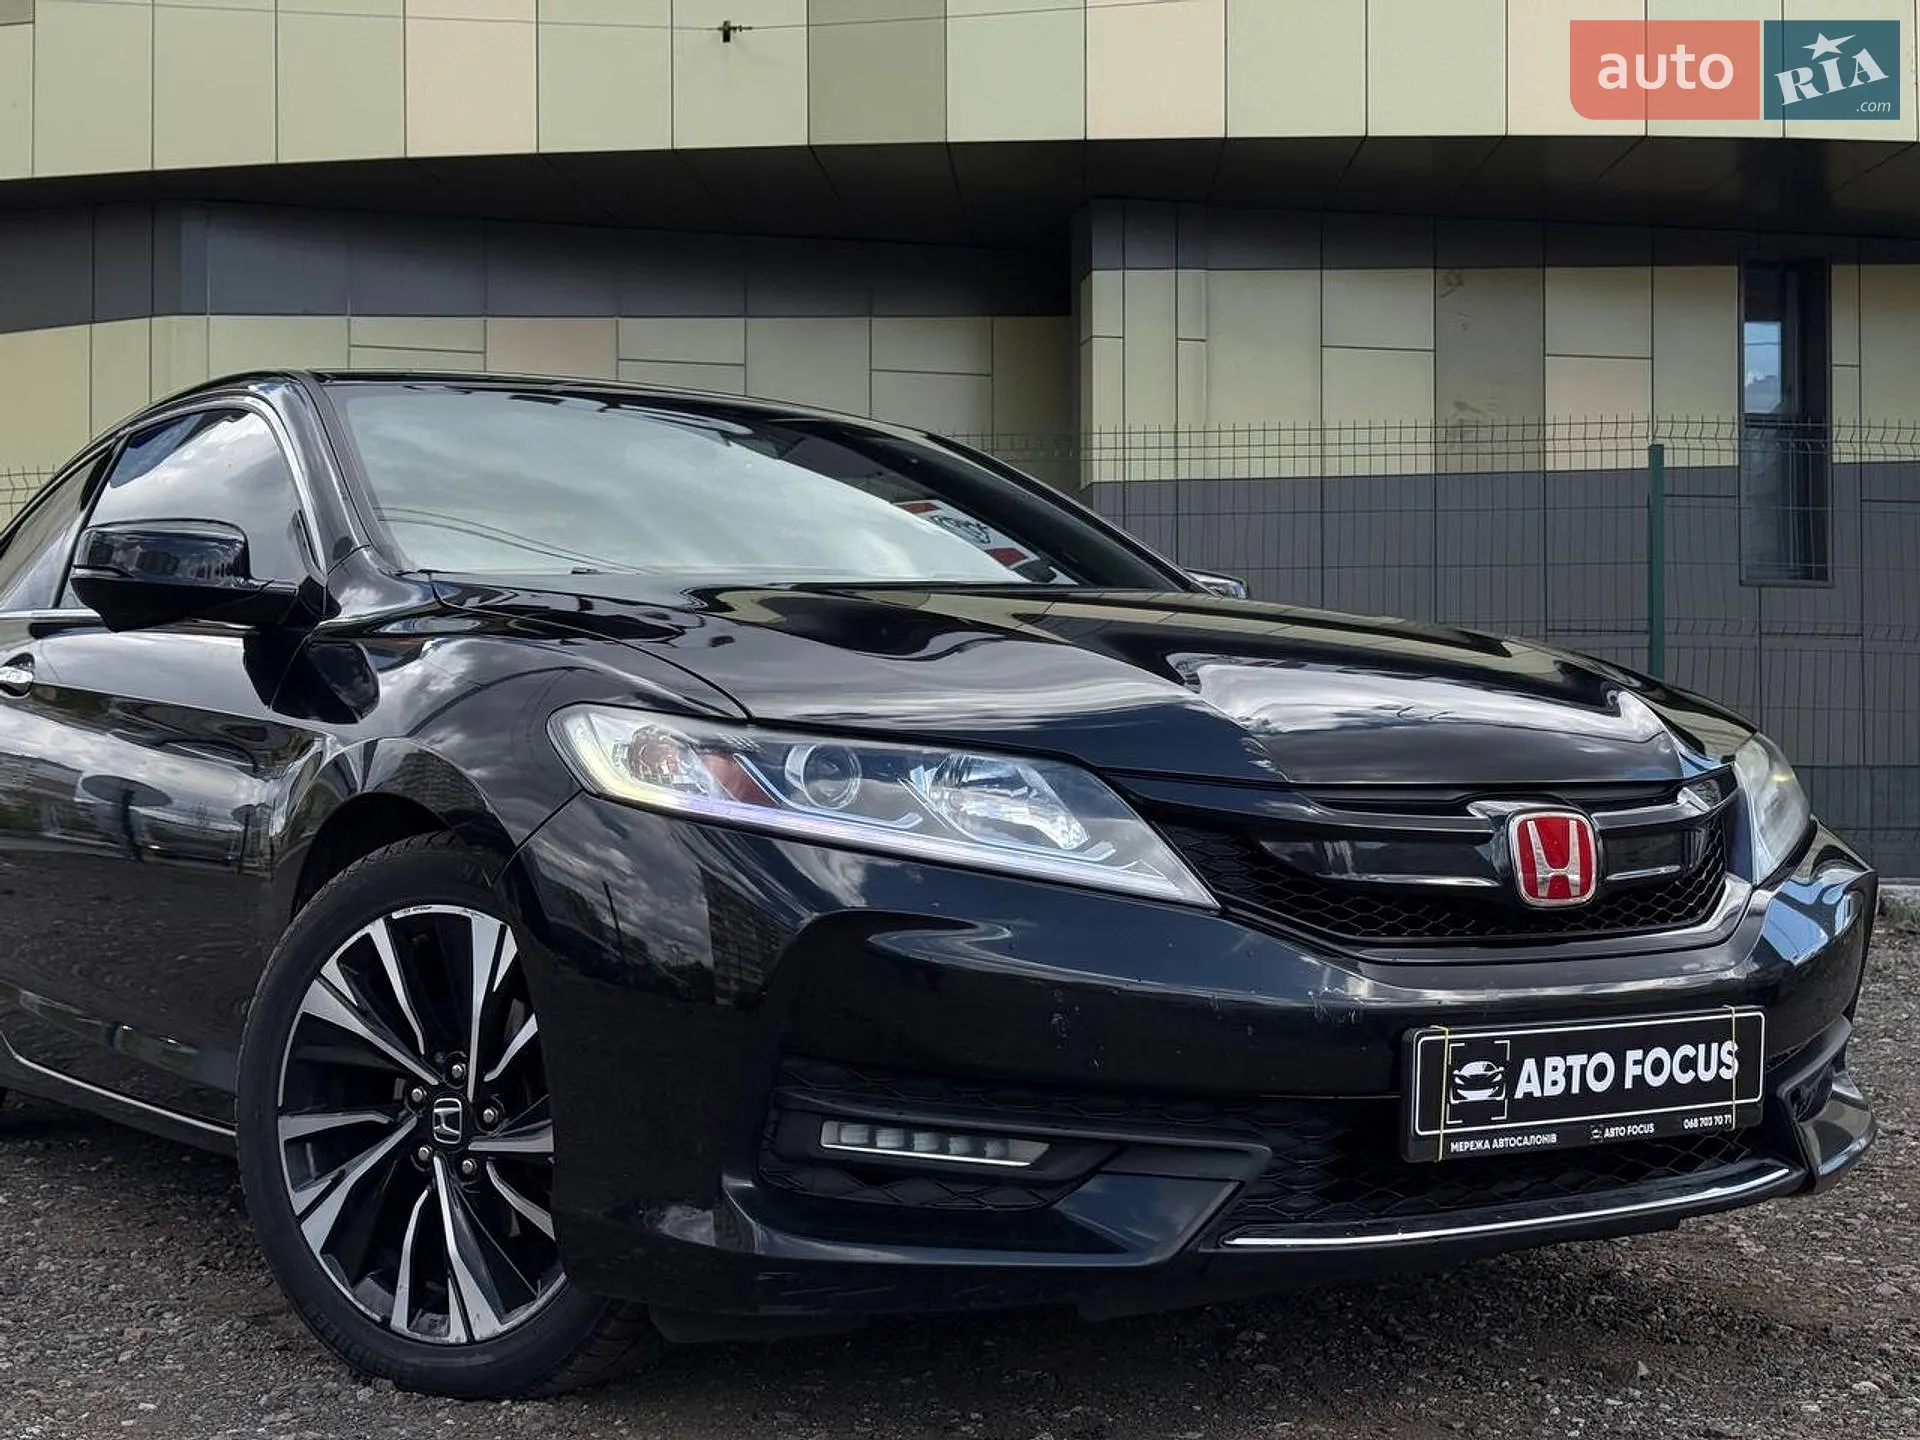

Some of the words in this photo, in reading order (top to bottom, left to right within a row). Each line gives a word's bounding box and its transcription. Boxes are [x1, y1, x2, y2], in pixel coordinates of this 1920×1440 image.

[1514, 1054, 1616, 1099] АВТО
[1624, 1040, 1739, 1089] FOCUS
[1627, 1122, 1655, 1135] FOCUS
[1450, 1139, 1490, 1152] МЕРЕЖА
